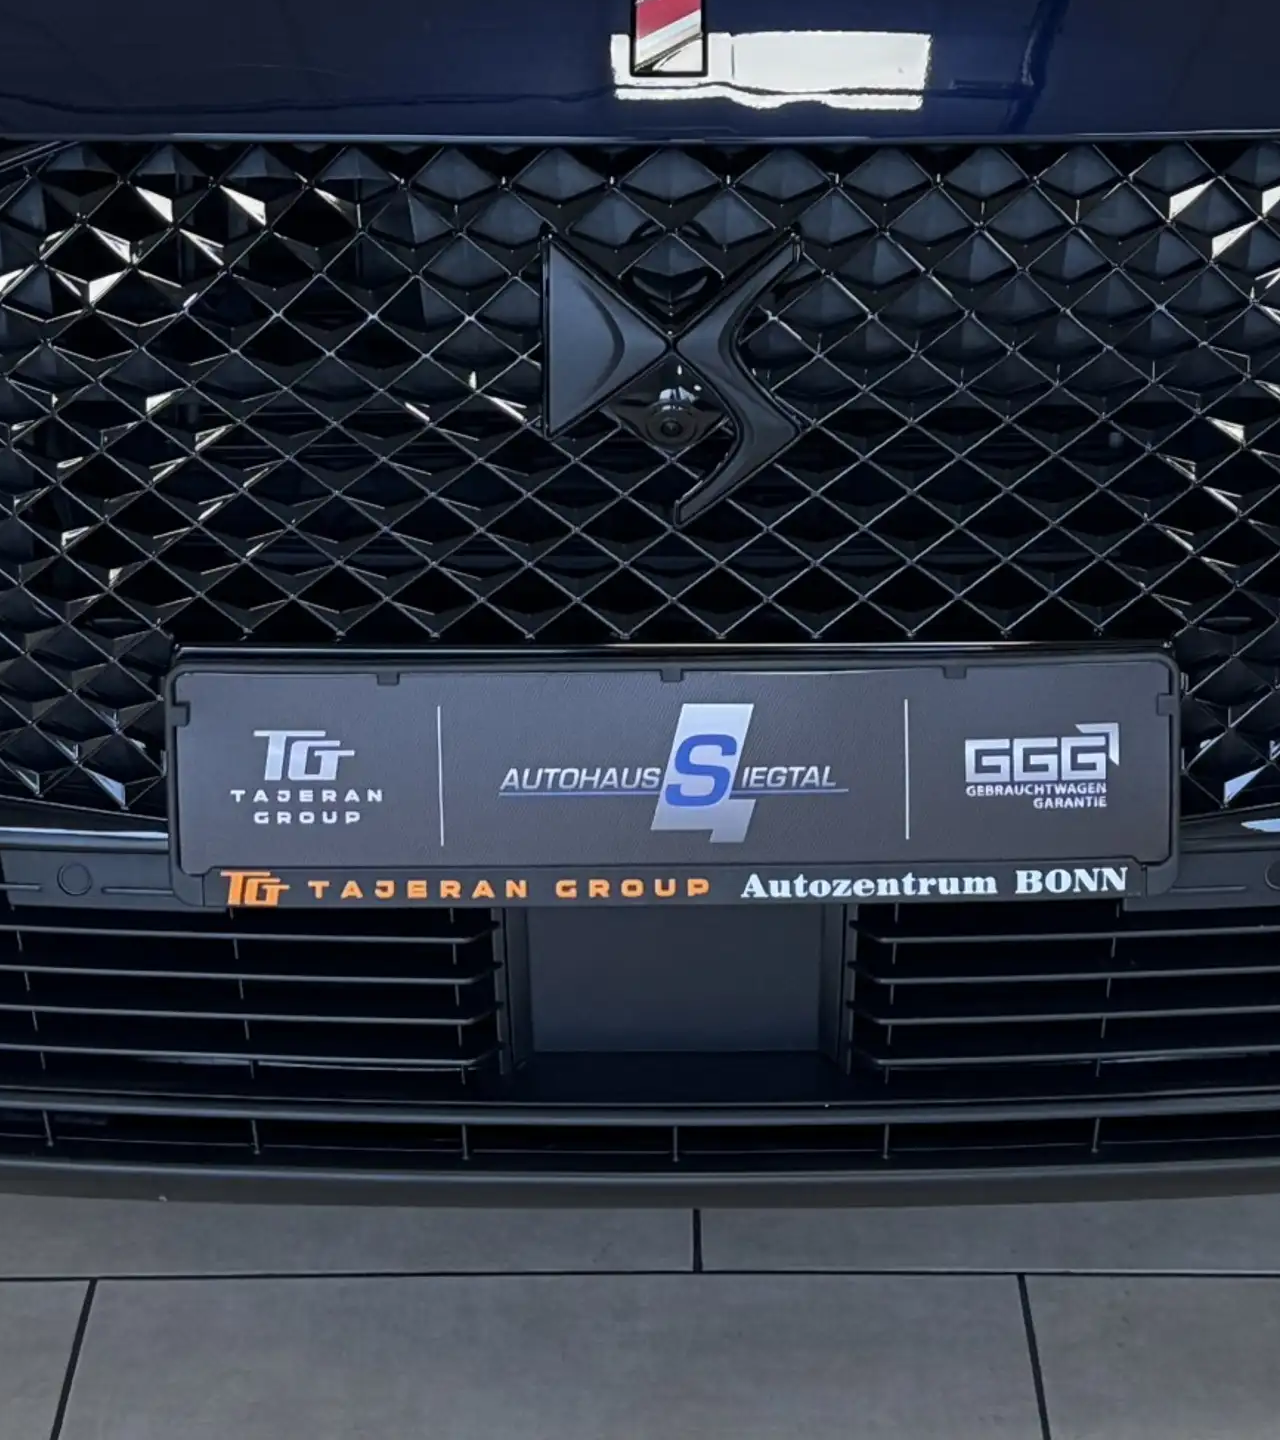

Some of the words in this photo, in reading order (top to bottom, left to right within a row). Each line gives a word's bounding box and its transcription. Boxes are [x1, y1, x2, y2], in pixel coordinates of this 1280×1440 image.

[540, 232, 804, 528] DS
[253, 730, 356, 781] TG
[965, 734, 1107, 783] GGG
[499, 767, 662, 791] AUTOHAUS
[965, 782, 1108, 798] GEBRAUCHTWAGEN
[230, 789, 383, 803] TAJERAN
[1032, 796, 1108, 810] GARANTIE
[254, 811, 361, 825] GROUP
[220, 870, 290, 907] TG
[308, 879, 527, 900] TAJERAN
[555, 878, 710, 899] GROUP
[740, 872, 998, 899] Autozentrum
[1014, 867, 1128, 895] BONN
